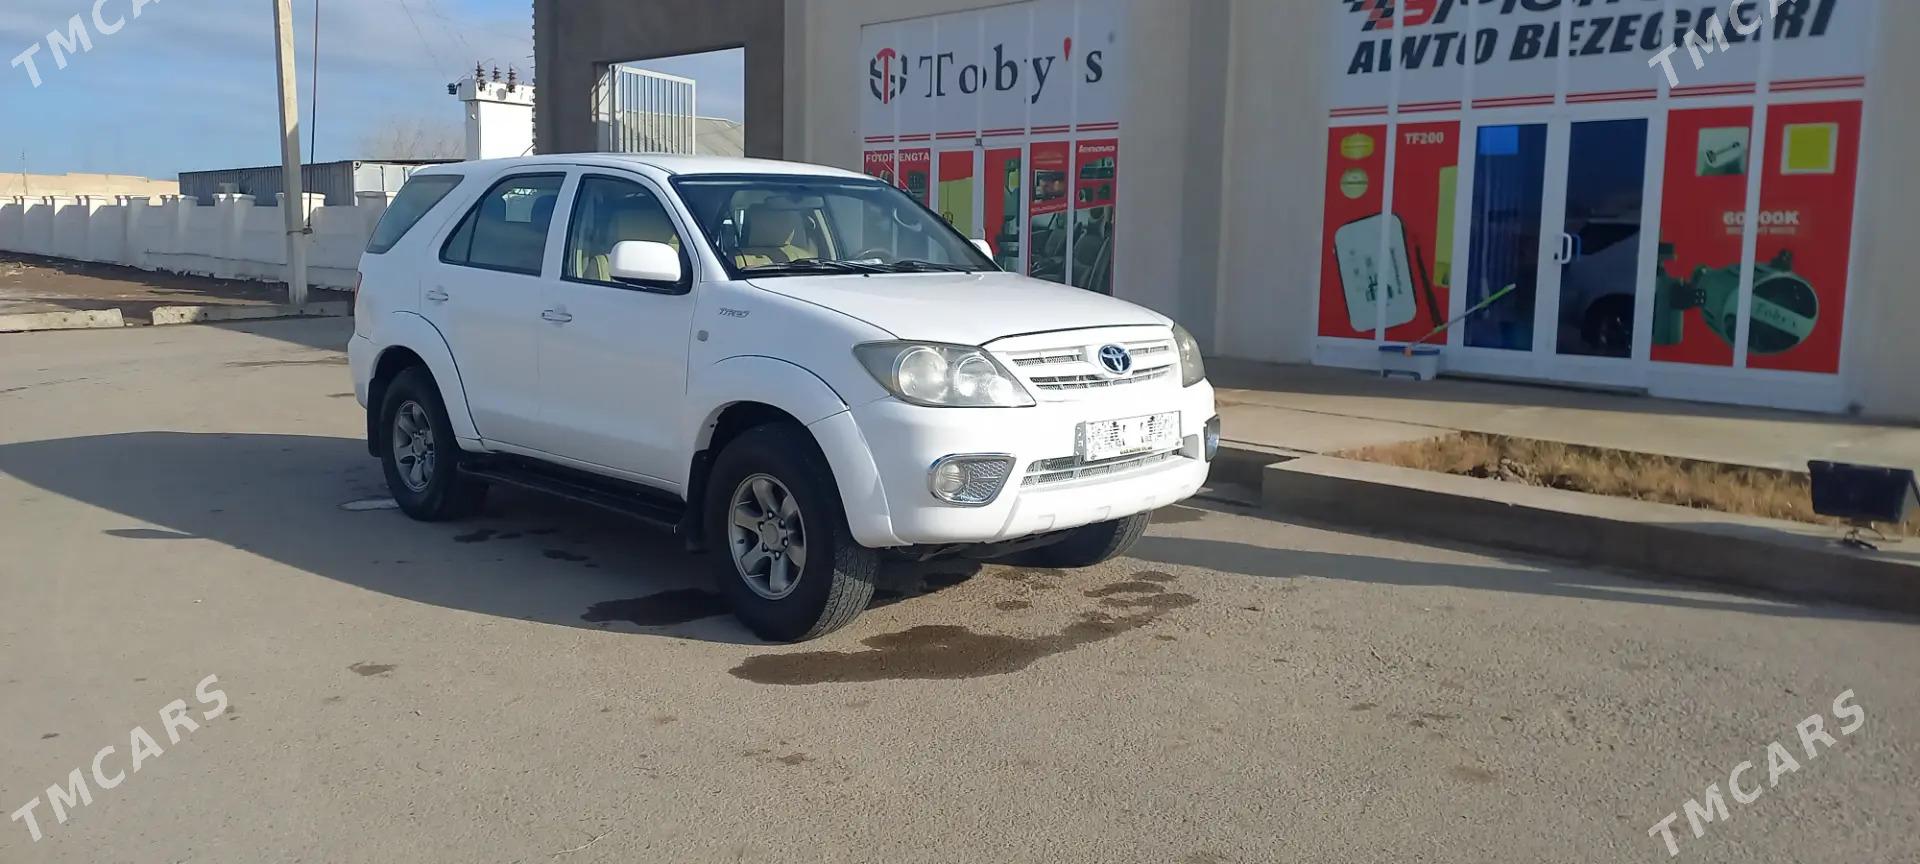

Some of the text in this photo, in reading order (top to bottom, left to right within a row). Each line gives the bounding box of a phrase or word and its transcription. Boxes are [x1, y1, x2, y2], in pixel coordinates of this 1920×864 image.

[919, 37, 1103, 104] Toby's
[1347, 28, 1498, 75] AWTO
[1404, 131, 1445, 145] TF200
